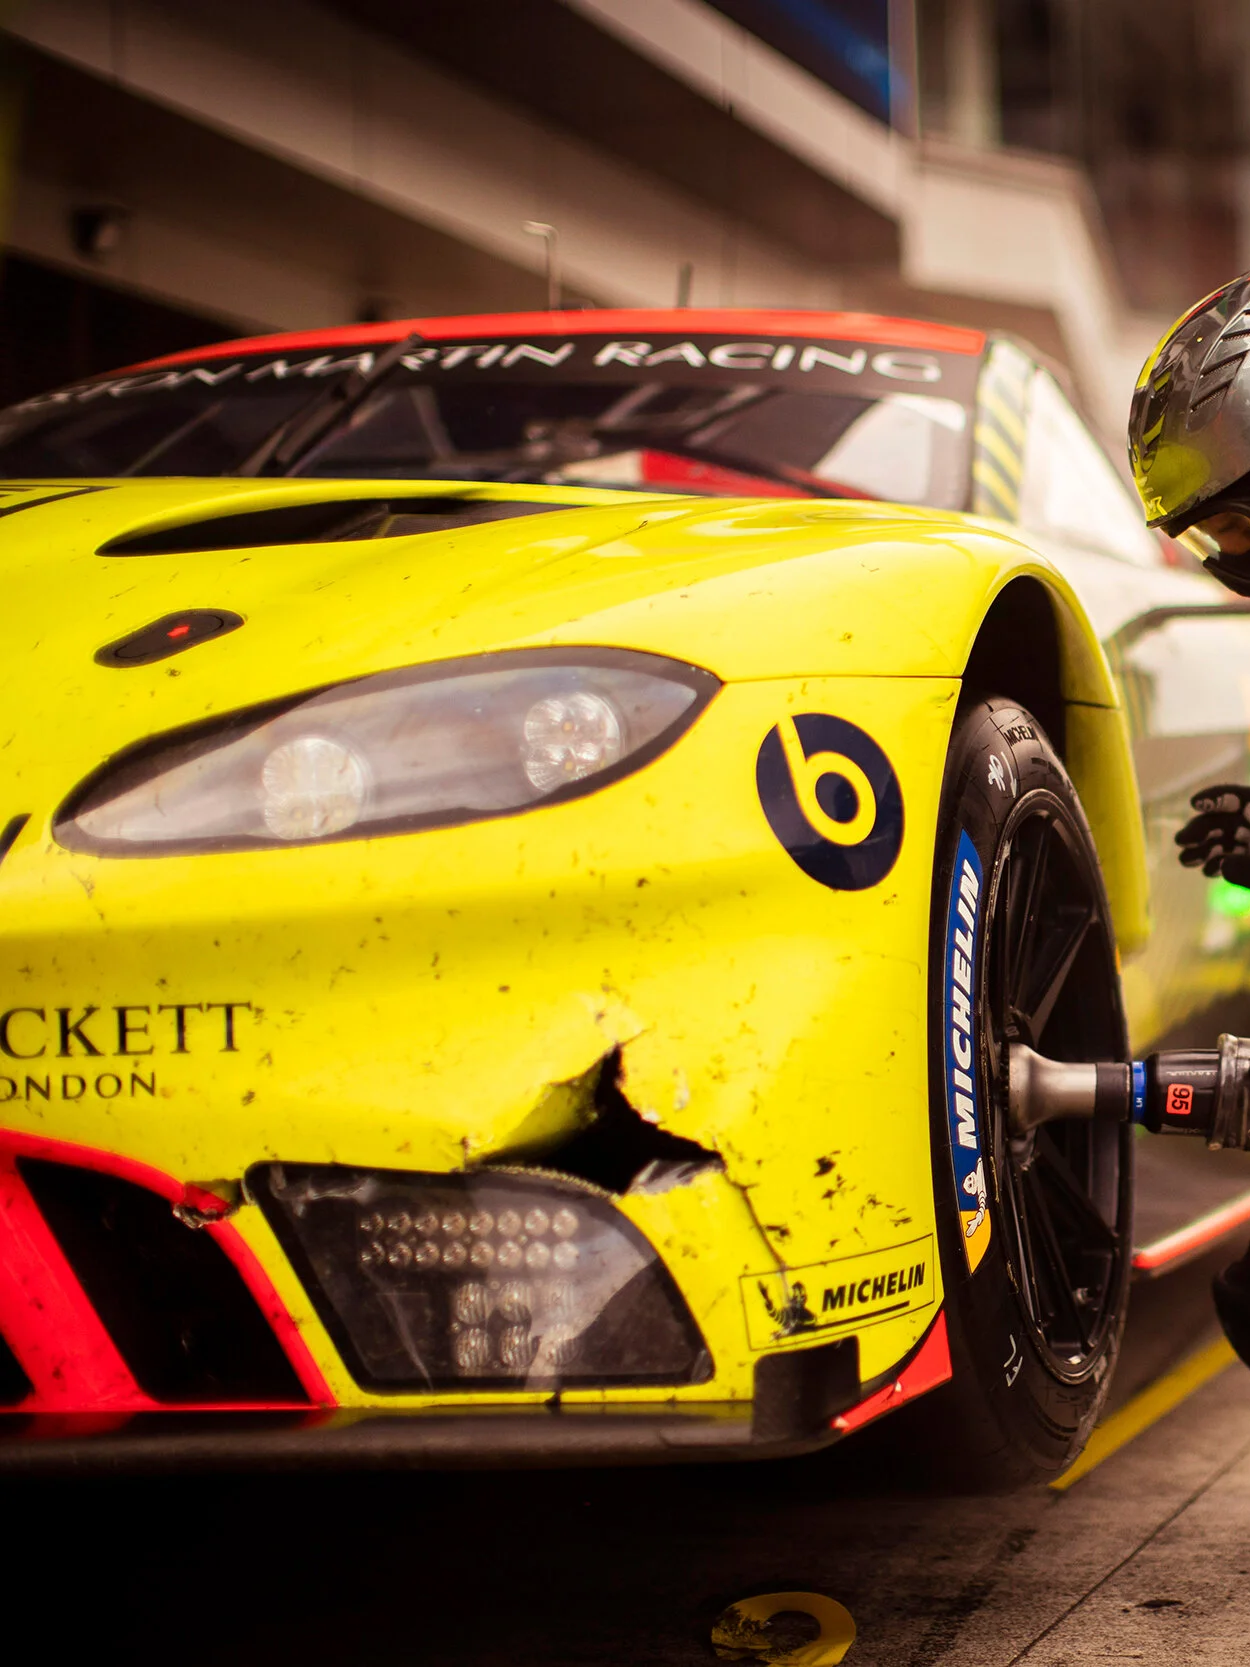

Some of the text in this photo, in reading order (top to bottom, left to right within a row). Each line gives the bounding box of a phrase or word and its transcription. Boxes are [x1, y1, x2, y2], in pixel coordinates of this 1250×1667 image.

[247, 343, 576, 384] MARTIN
[594, 341, 943, 382] RACING
[950, 858, 980, 1150] MICHELIN
[1172, 1086, 1191, 1112] 95
[821, 1262, 926, 1313] MICHELIN
